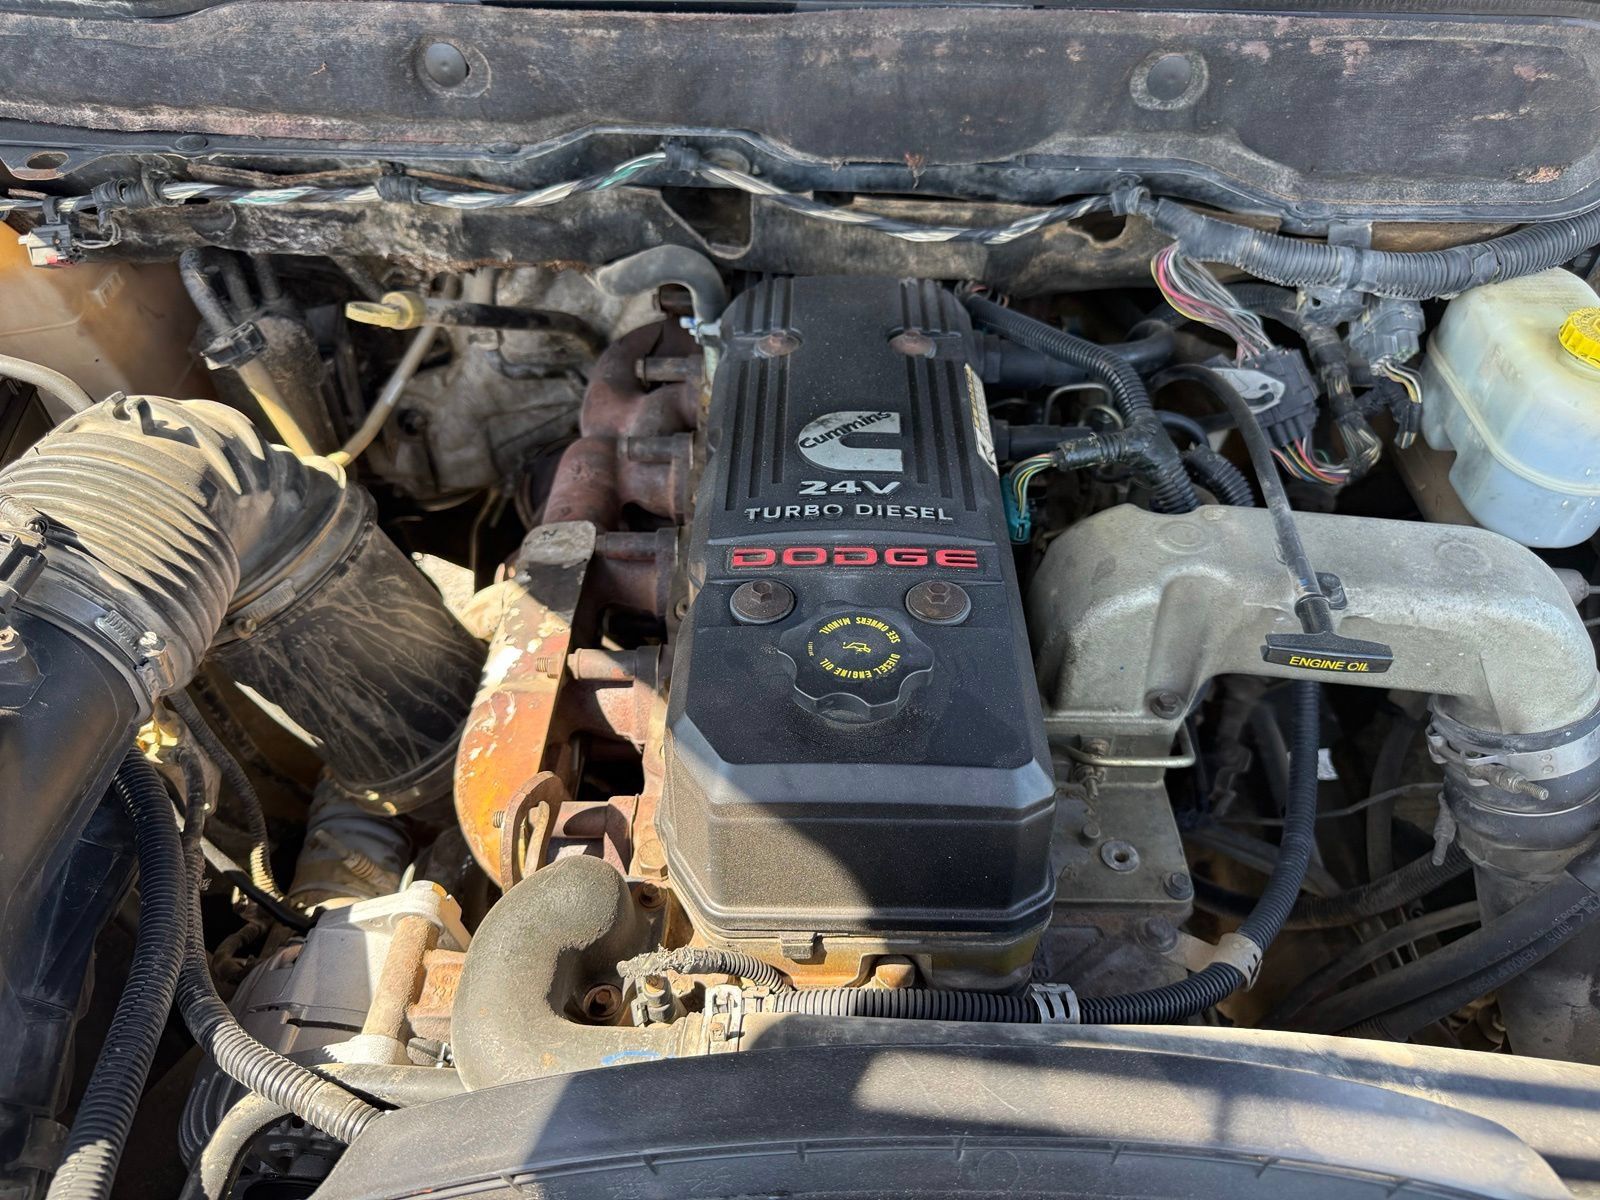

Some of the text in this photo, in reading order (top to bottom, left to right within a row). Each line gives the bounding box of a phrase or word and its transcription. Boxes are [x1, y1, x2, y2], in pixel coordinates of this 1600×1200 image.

[799, 411, 892, 449] Cummins
[799, 480, 901, 496] 24V
[745, 503, 954, 521] TURBO DIESEL
[731, 547, 978, 568] DODGE
[819, 616, 900, 643] SEE OWNERS MANUAL
[820, 653, 900, 678] DIESEL ENGINE OIL
[1290, 656, 1369, 671] ENGINE OIL
